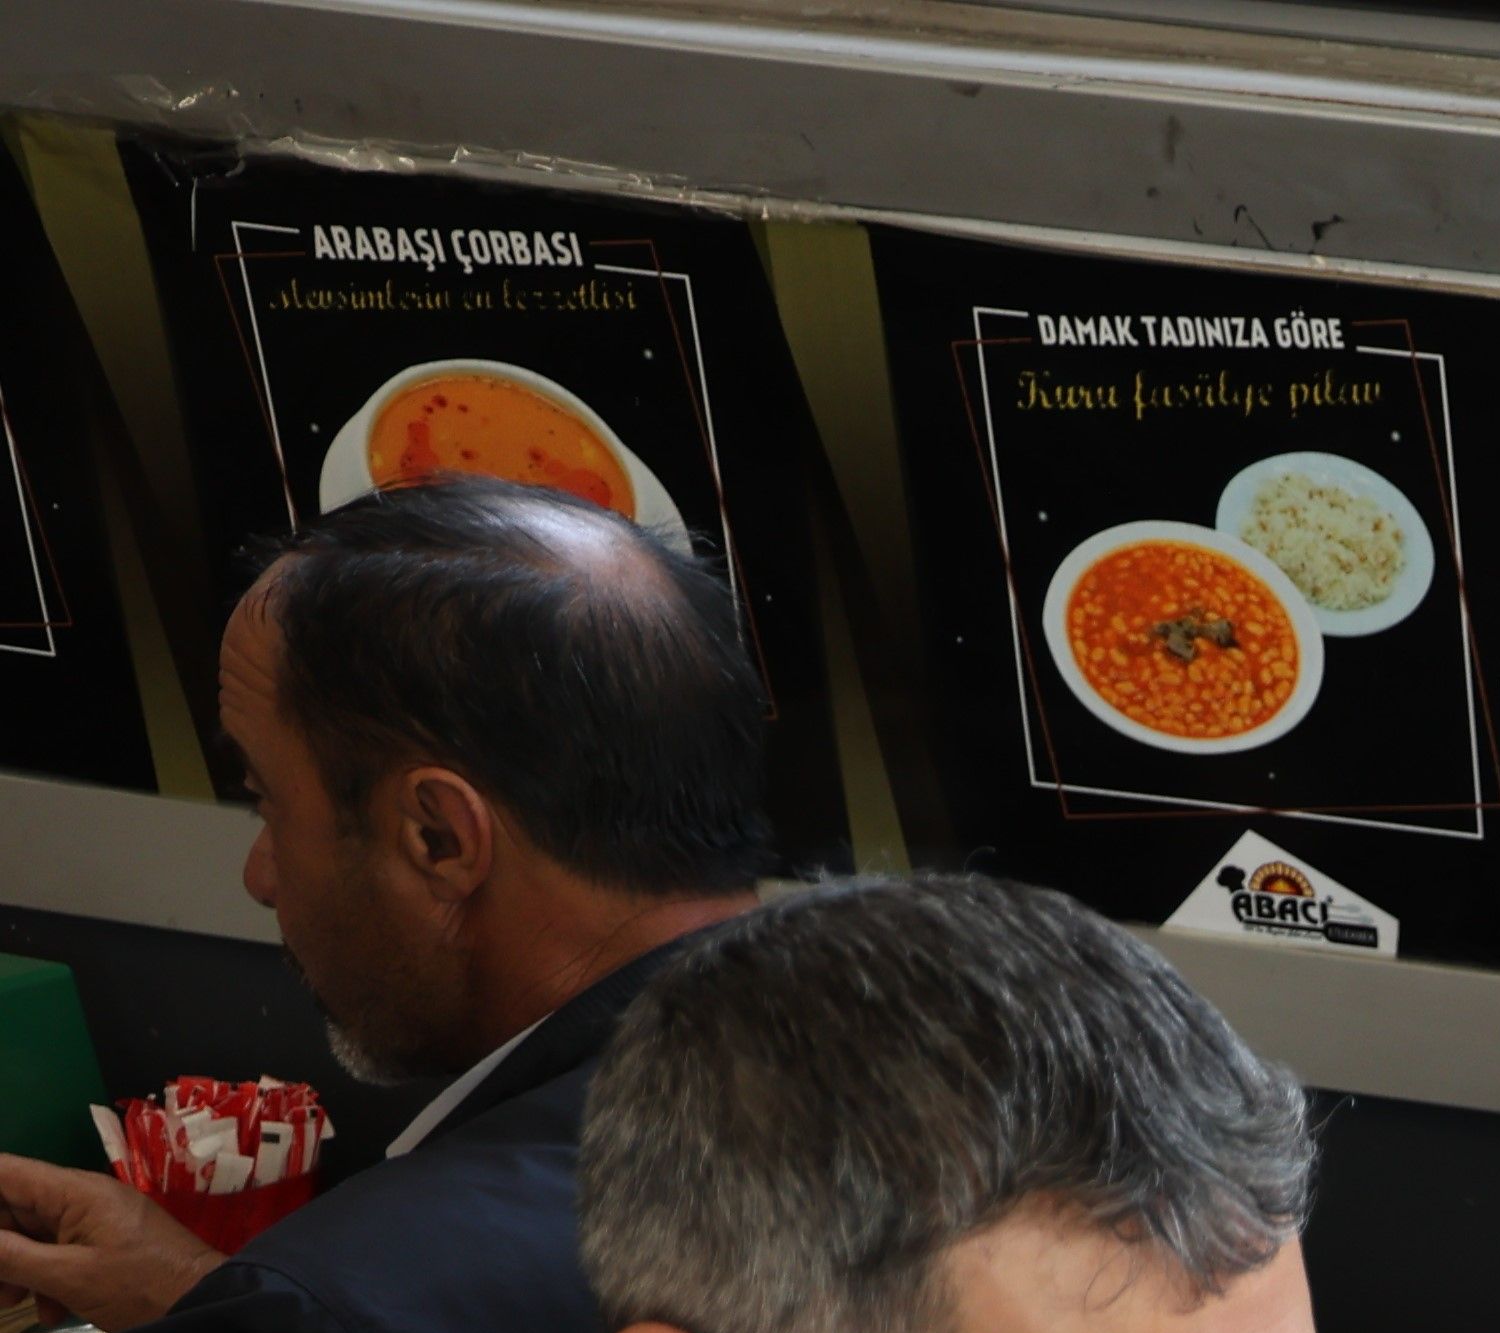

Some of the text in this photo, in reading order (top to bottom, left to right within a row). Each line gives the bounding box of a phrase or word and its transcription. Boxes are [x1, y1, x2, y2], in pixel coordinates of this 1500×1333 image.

[313, 224, 583, 274] ARABAŞI ÇORBASI
[1037, 310, 1345, 349] DAMAK TADINIZA GÖRE
[1016, 370, 1119, 410] Kuru
[1231, 890, 1329, 925] ABACI
